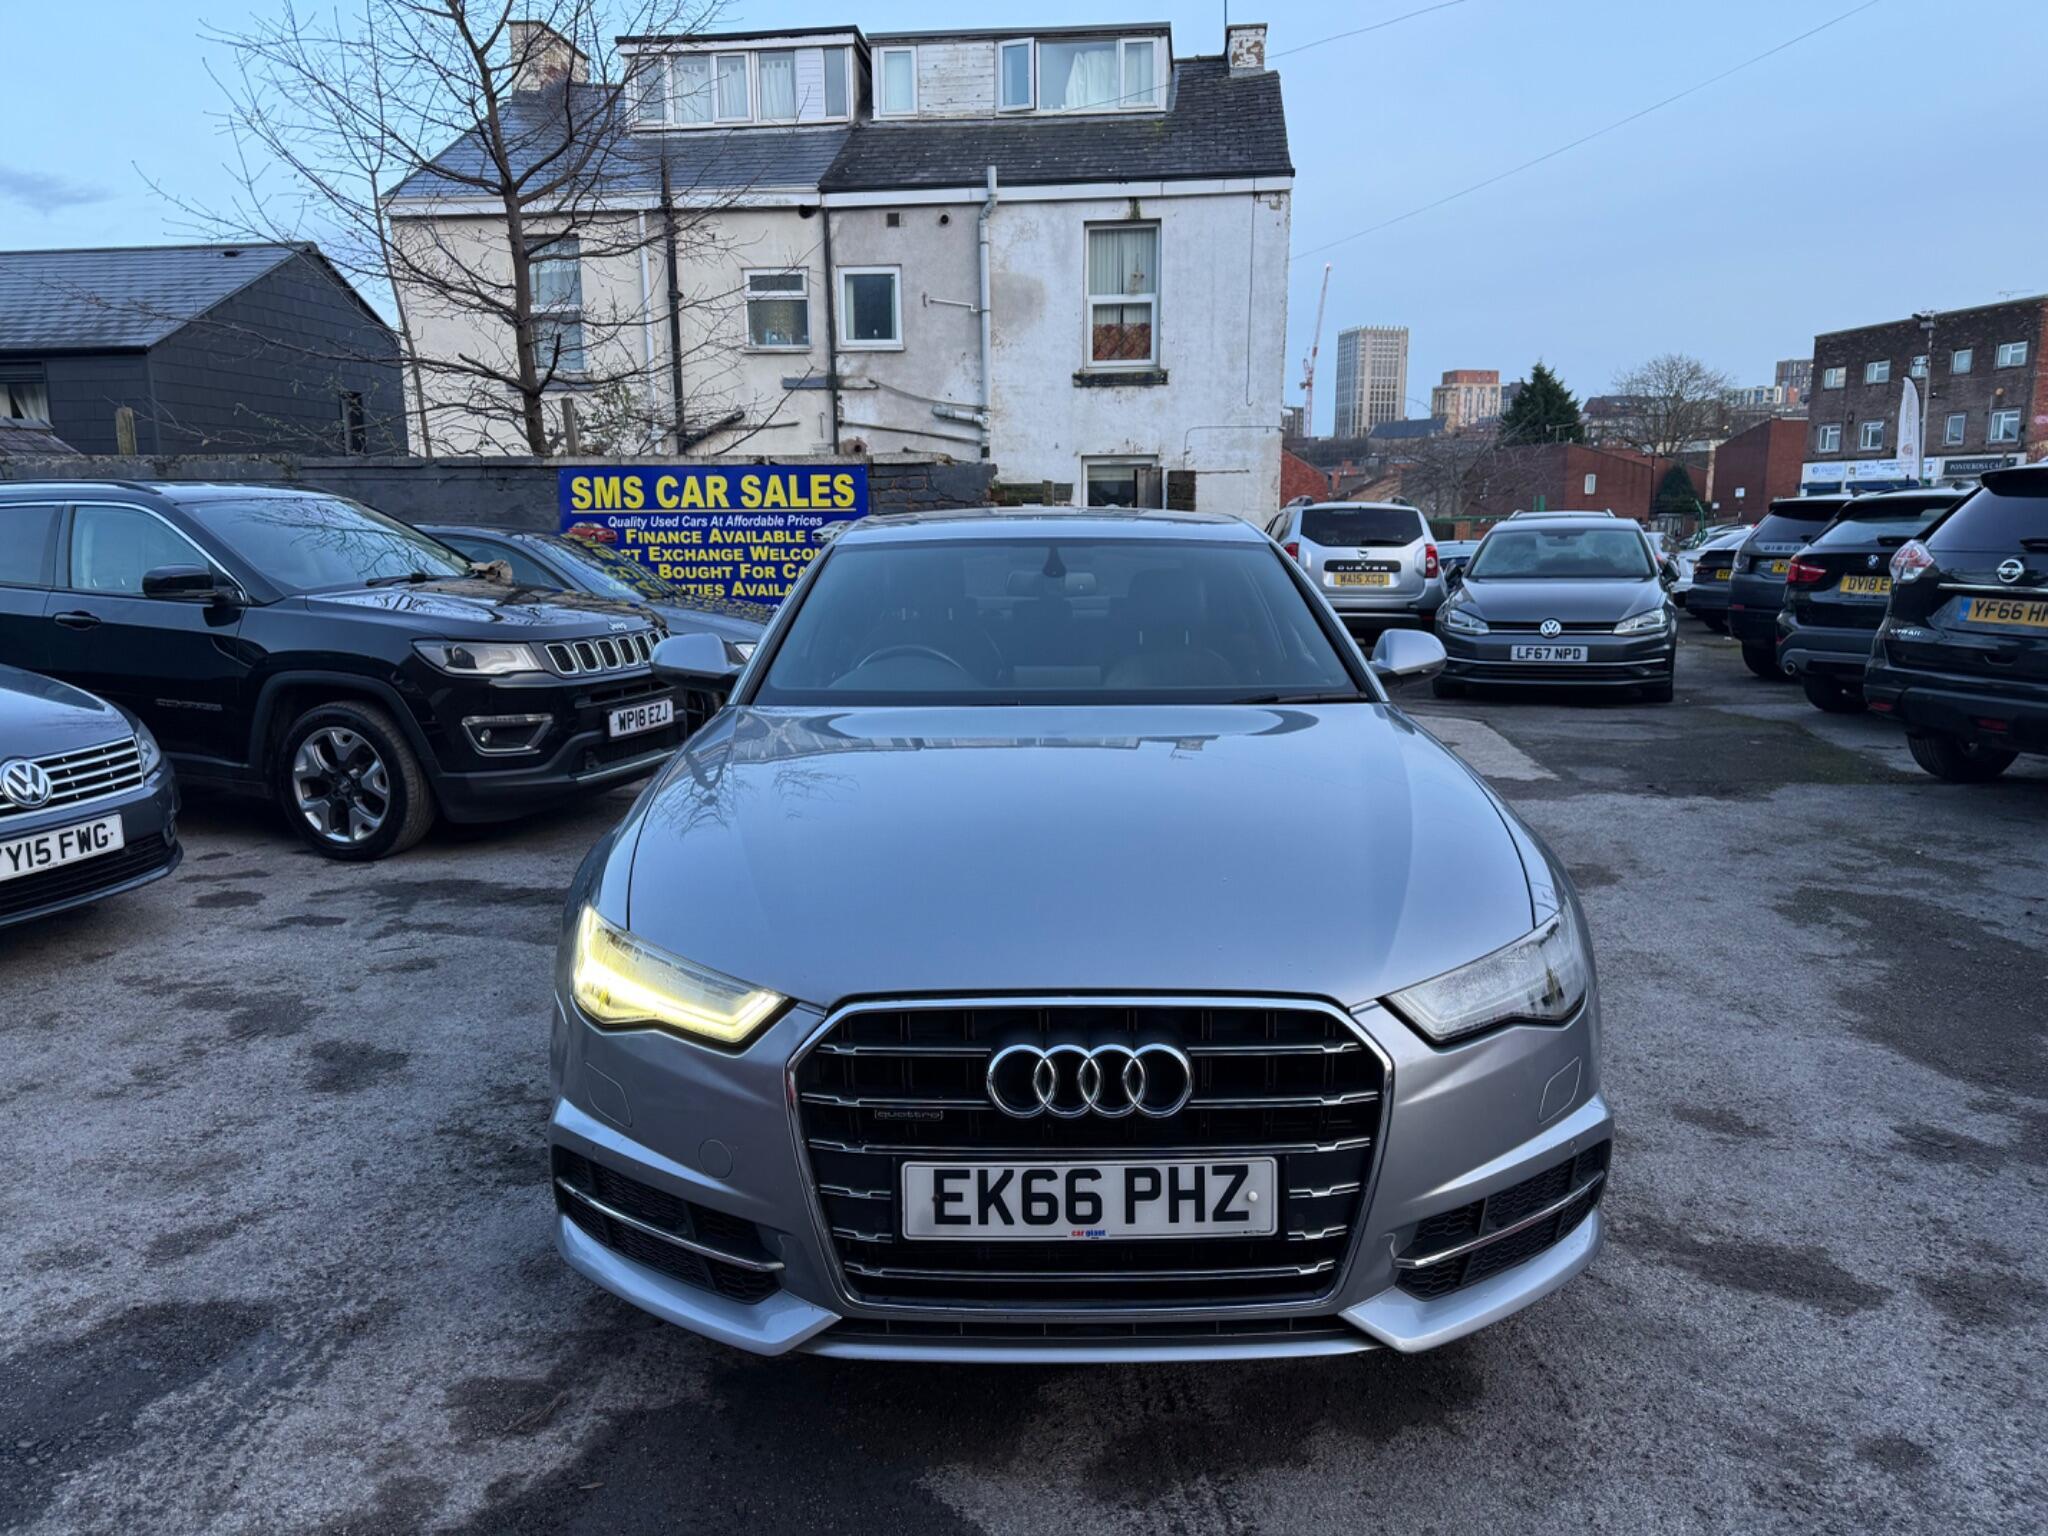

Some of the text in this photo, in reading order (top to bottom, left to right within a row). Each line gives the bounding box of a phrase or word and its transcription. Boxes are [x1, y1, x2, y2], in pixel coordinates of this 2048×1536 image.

[571, 474, 855, 509] SMS CAR SALES
[608, 514, 822, 529] Quality Used Cars At Affordable Prices
[626, 528, 806, 544] FINANCE AVAILABLE
[648, 546, 744, 561] EXCHANGE
[658, 564, 733, 579] BOUGHT
[740, 564, 776, 579] FOR
[731, 581, 795, 596] AVAILA
[1975, 600, 2024, 620] YF66
[1517, 648, 1581, 660] LF67 NPD
[618, 703, 668, 731] WP18 EZJ
[0, 823, 108, 872] Y15 FWG
[933, 1165, 1249, 1225] EK66 PHZ
